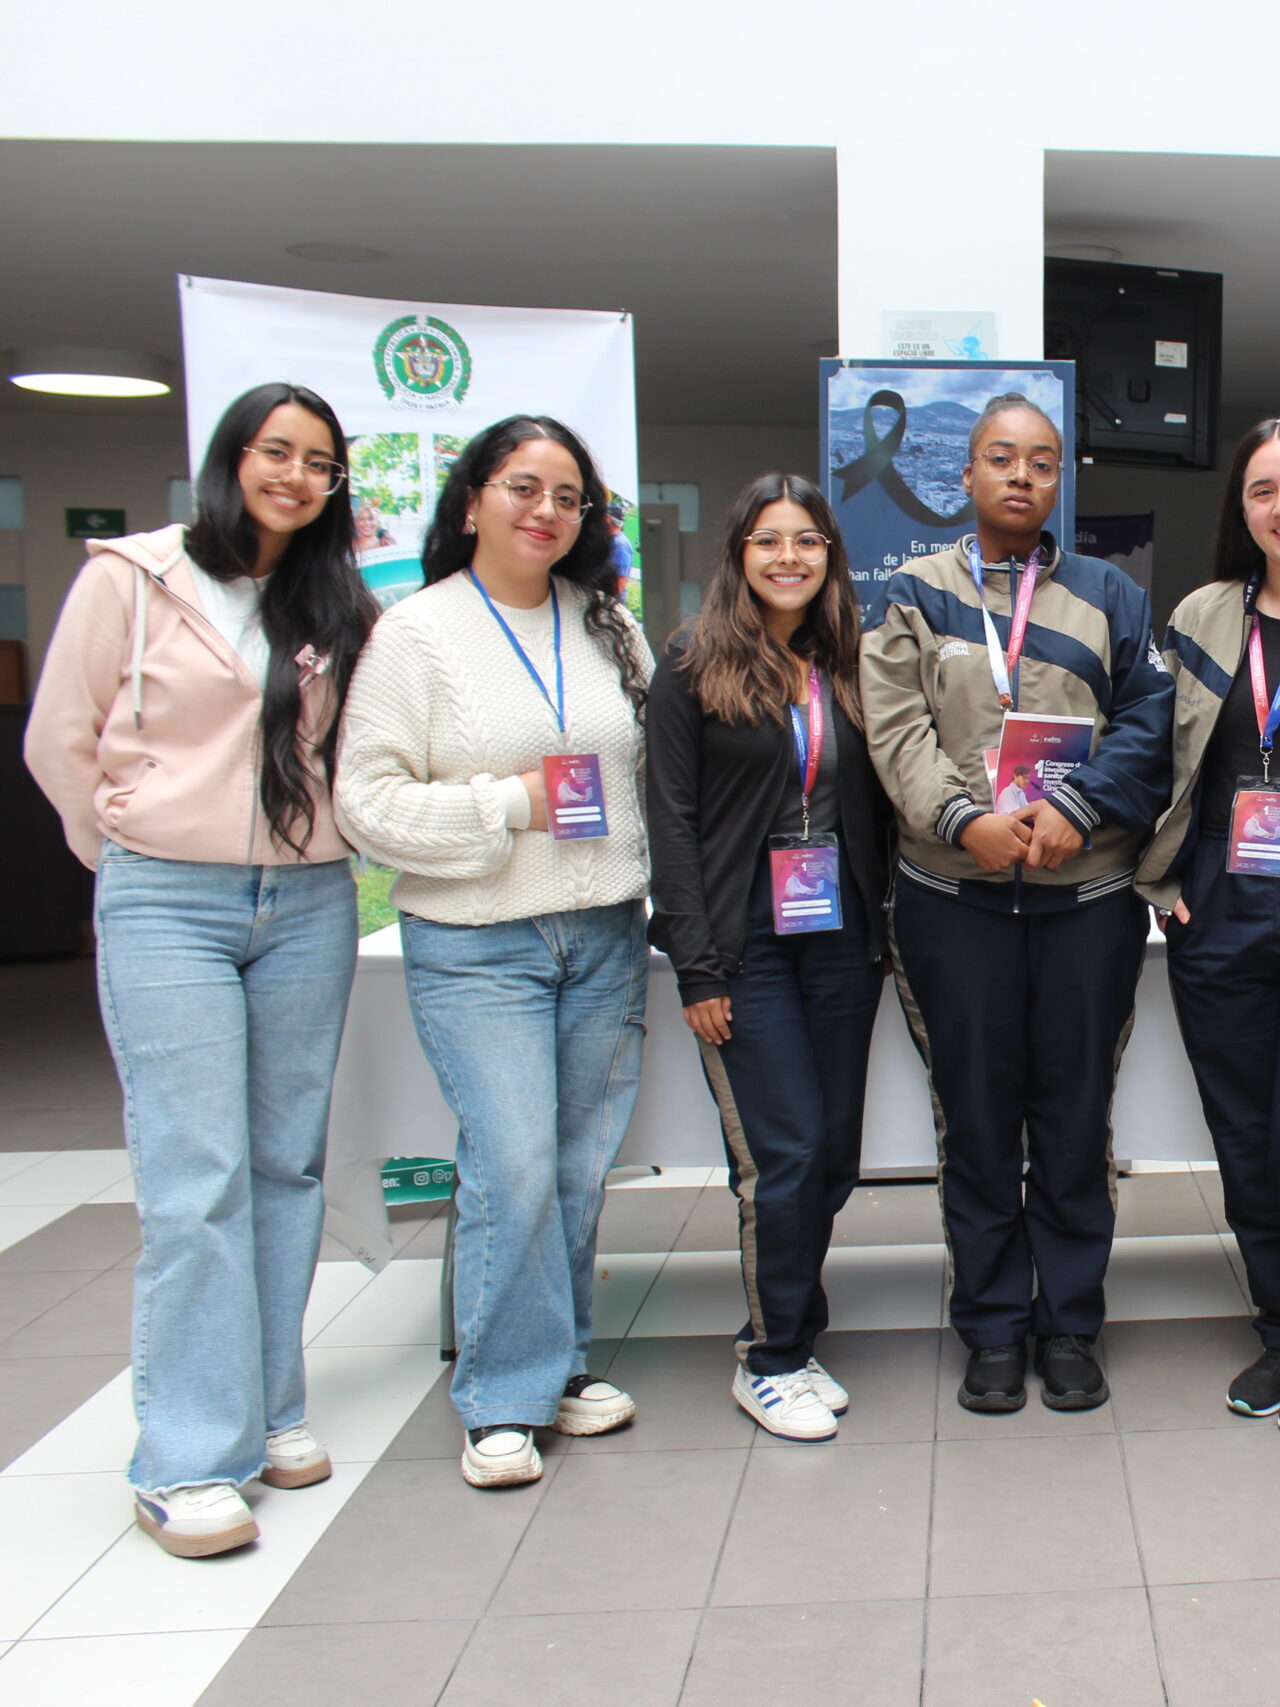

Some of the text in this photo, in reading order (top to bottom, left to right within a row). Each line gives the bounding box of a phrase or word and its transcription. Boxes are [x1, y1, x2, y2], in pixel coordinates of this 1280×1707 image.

[911, 540, 926, 553] En
[883, 553, 898, 566] de
[1035, 760, 1044, 778] 1
[1045, 760, 1075, 768] Congreso
[382, 1176, 400, 1188] en:
